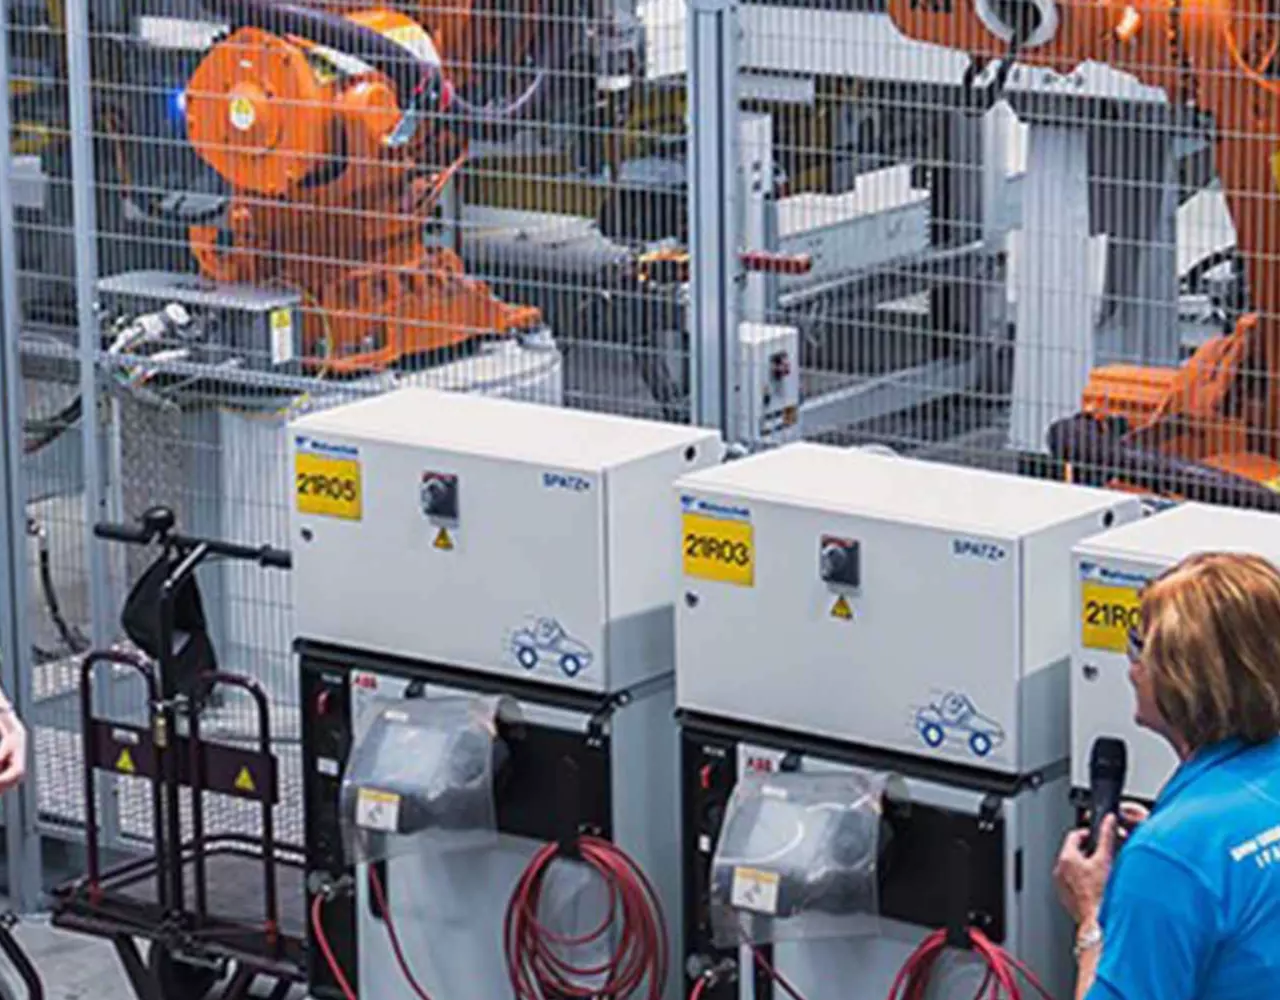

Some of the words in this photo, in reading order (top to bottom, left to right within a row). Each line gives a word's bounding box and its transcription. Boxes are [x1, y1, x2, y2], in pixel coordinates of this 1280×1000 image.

[296, 472, 357, 503] 21R05
[685, 533, 751, 567] 21R03
[1086, 600, 1142, 631] 21R0
